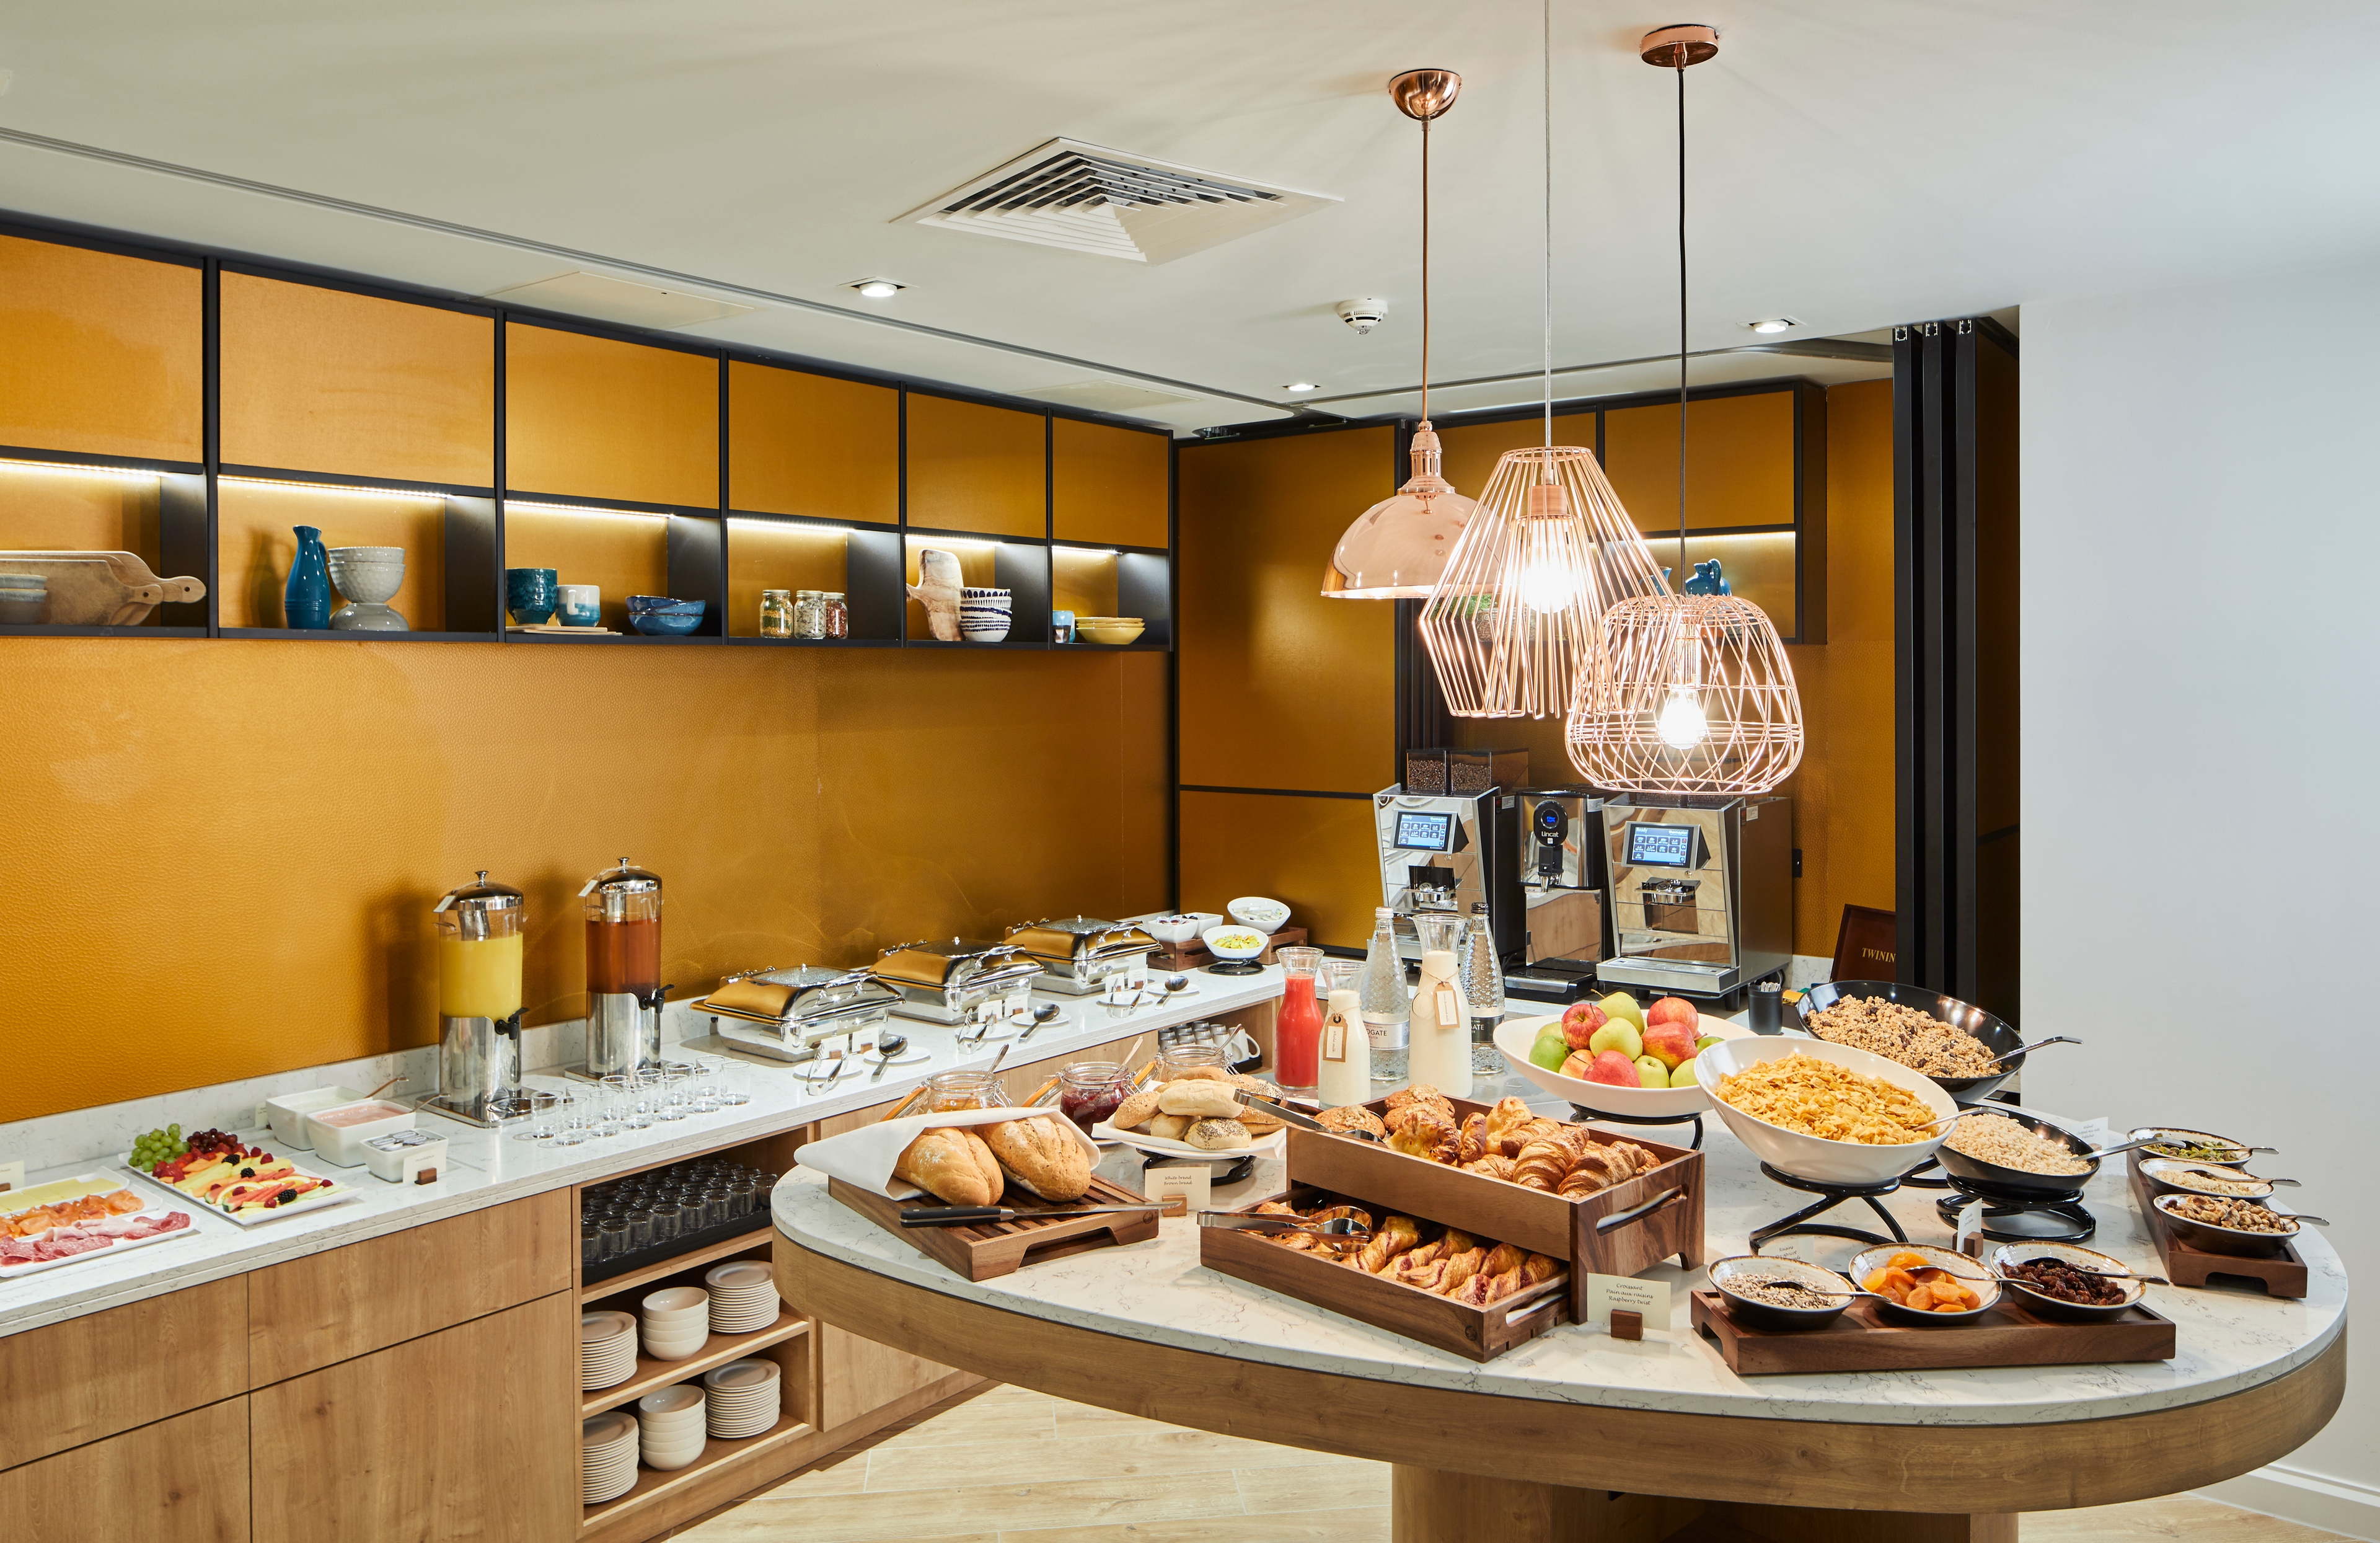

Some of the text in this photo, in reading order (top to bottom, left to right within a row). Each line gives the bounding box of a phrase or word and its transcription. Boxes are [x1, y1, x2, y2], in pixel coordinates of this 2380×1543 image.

[1862, 947, 1896, 963] TWININ
[1366, 1028, 1387, 1037] OGATE
[1608, 1296, 1636, 1304] Raspberry
